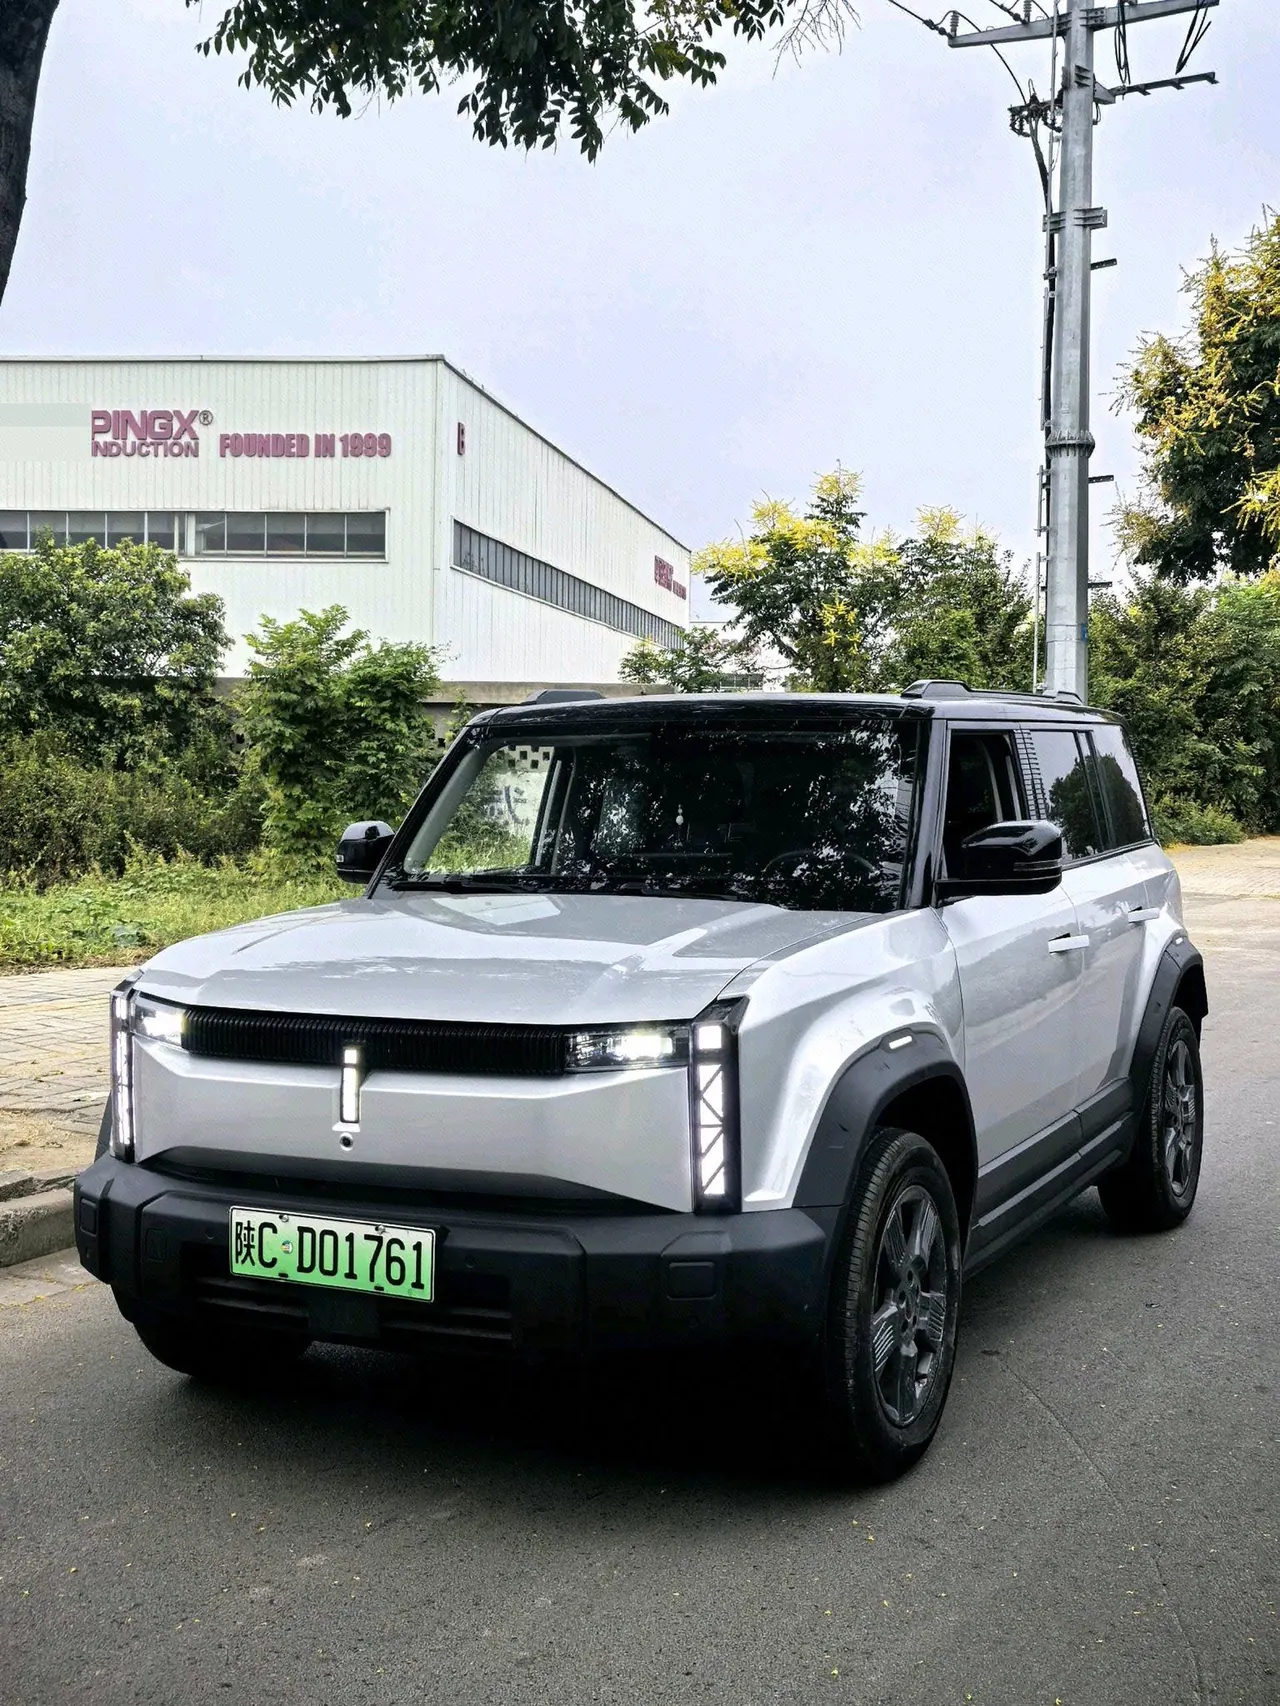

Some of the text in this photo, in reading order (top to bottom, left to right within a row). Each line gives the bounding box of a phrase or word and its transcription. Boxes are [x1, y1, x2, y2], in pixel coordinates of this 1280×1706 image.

[219, 432, 392, 458] FOUNDED IN 1999
